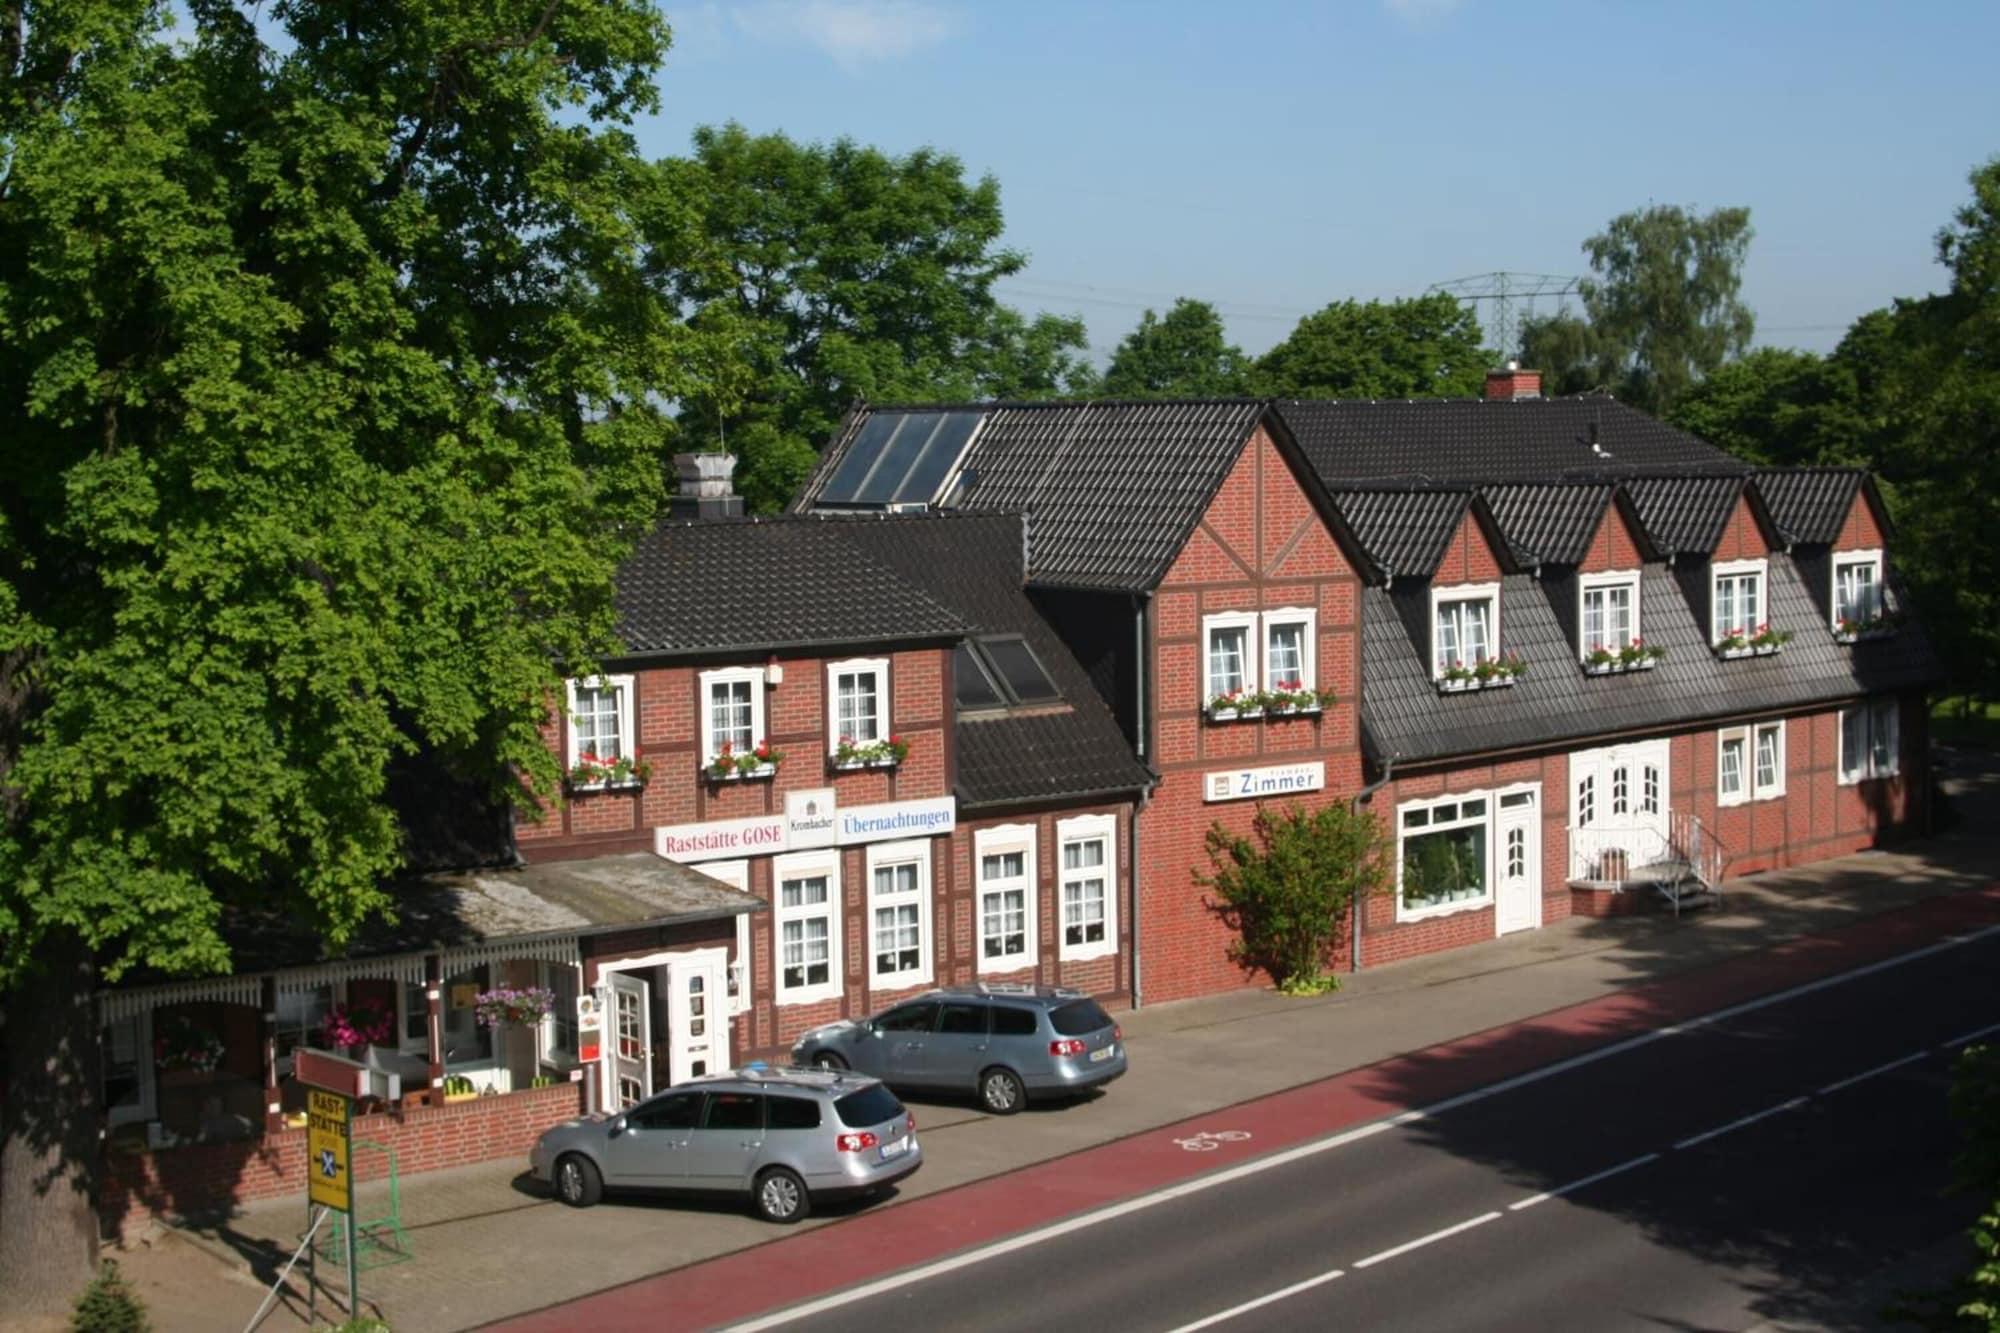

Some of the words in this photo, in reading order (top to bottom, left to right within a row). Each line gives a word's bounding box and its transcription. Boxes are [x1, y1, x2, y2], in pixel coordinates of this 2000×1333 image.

[1240, 773, 1314, 793] Zimmer
[843, 810, 950, 833] Übernachtungen
[666, 829, 738, 853] Raststätte
[742, 825, 781, 846] GOSE
